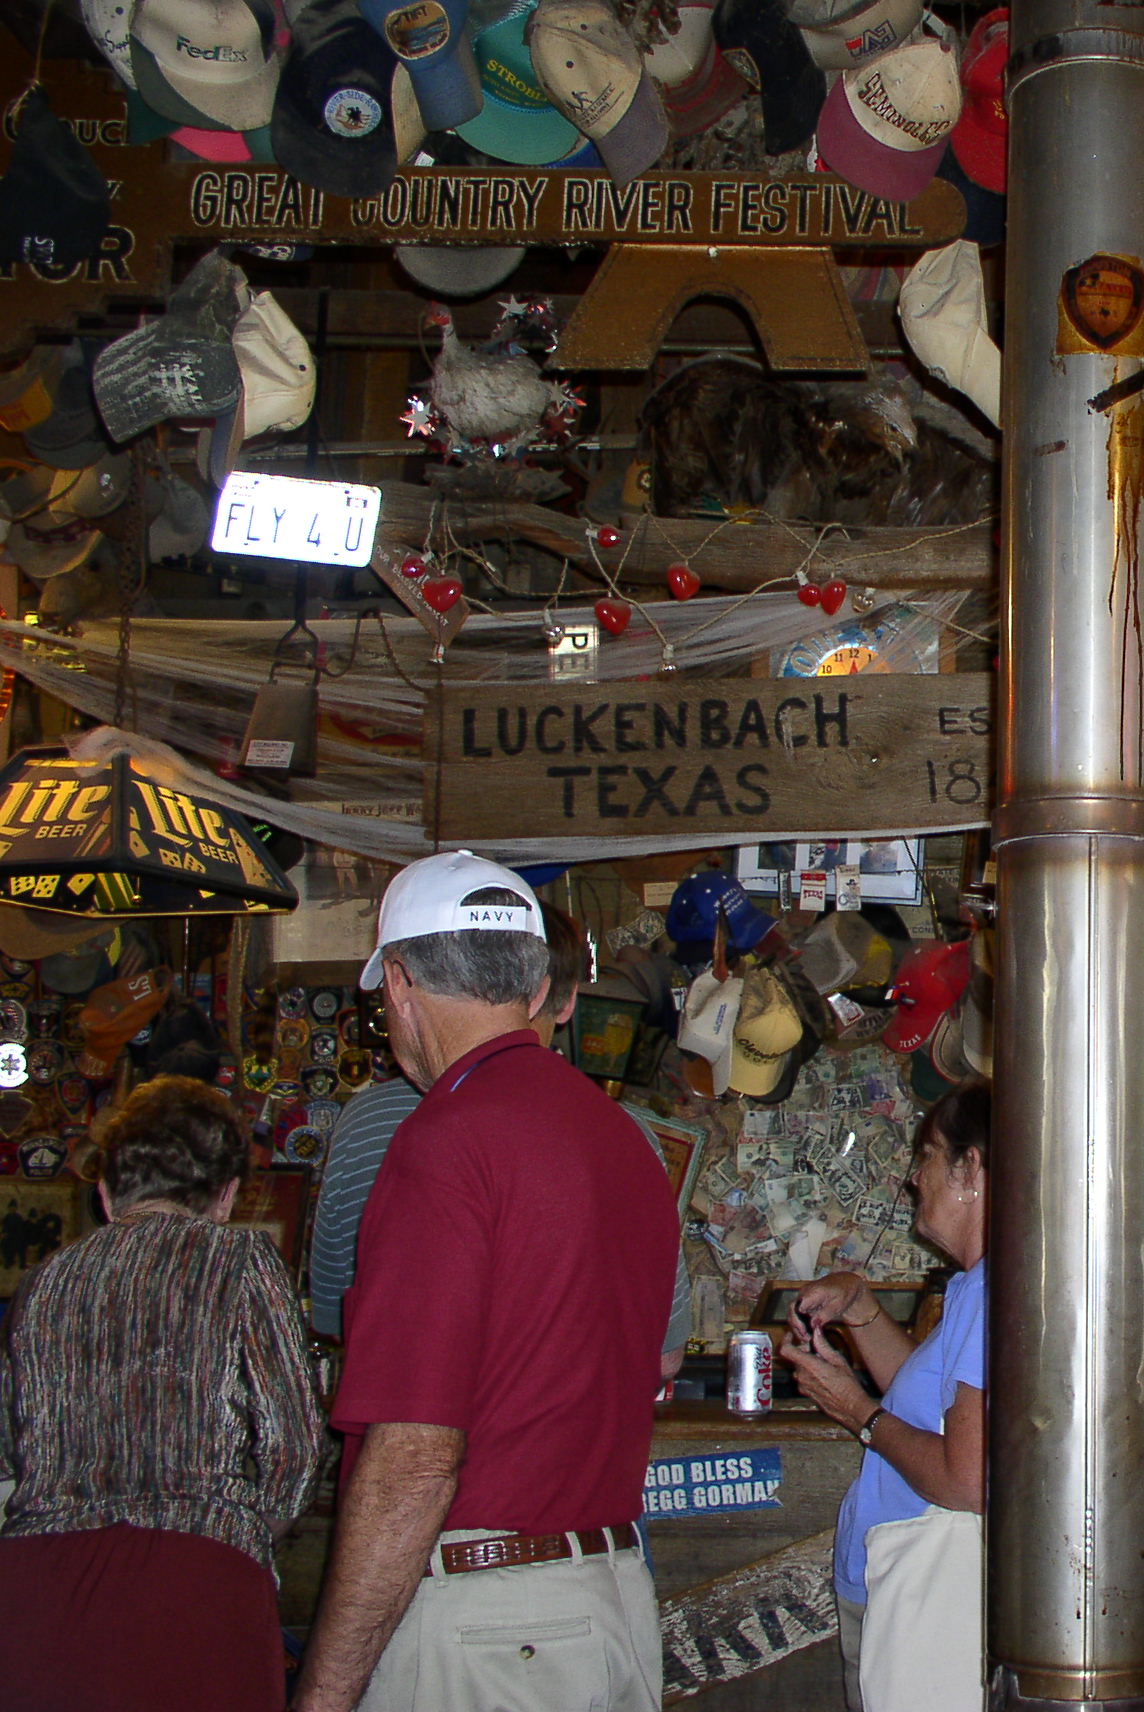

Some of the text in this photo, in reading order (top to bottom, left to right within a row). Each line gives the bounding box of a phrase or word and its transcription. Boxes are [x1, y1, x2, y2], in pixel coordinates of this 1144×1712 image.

[176, 34, 248, 63] FedEx
[857, 70, 951, 145] SEMINOLES
[562, 178, 694, 234] RIVER
[711, 181, 924, 239] FESTIVAL
[225, 503, 364, 551] FLY 4 U
[849, 648, 860, 659] 12
[462, 692, 849, 759] LUCKENBACH
[0, 779, 112, 838] Lite
[131, 780, 232, 848] Lite
[546, 763, 772, 819] TEXAS
[35, 824, 87, 840] BEER
[199, 842, 240, 865] BEER
[470, 911, 513, 922] NAVY
[756, 1347, 772, 1407] Coke
[644, 1457, 753, 1488] GOD BLESS
[692, 1480, 780, 1509] GORMAN
